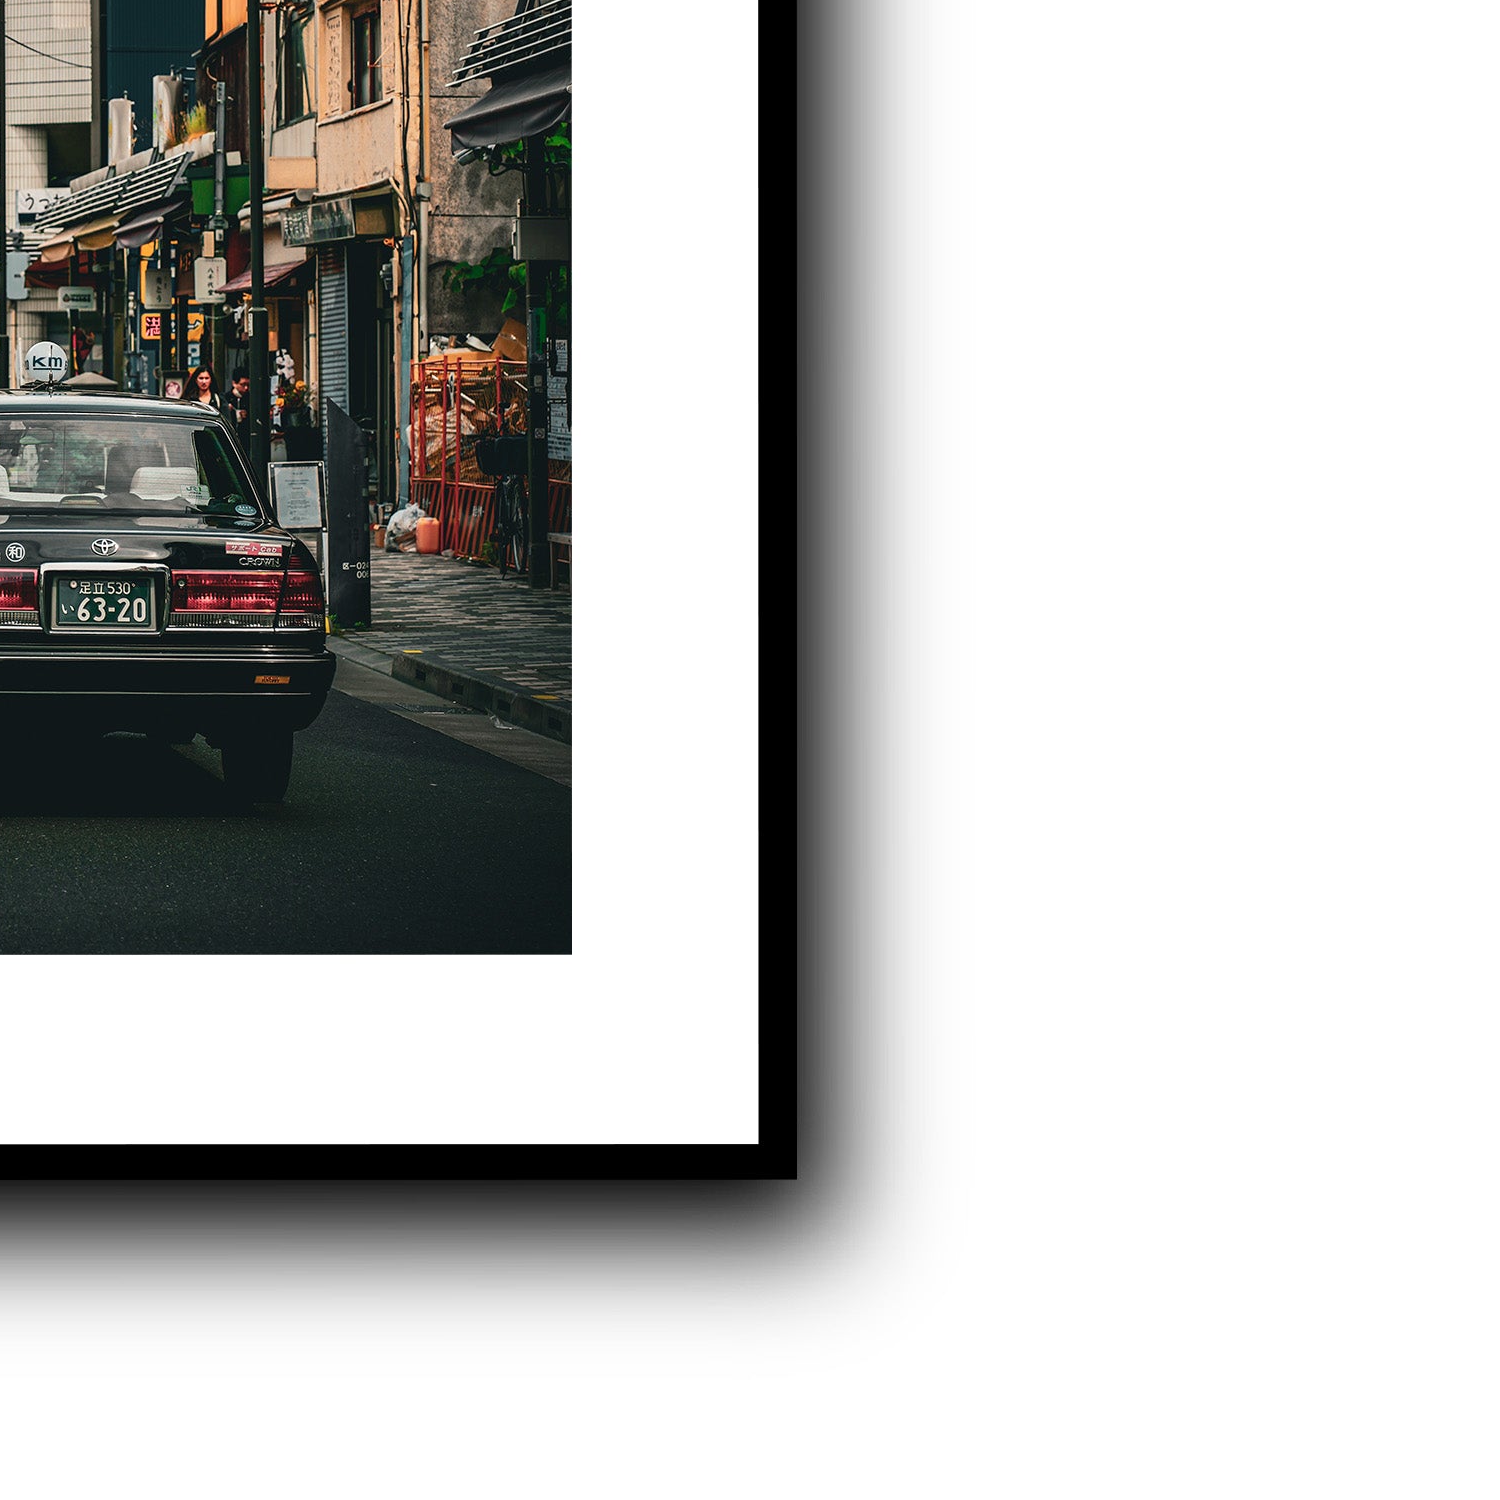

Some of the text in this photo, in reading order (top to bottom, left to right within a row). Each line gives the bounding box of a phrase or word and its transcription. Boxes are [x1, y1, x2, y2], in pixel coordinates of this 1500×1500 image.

[8, 545, 23, 559] 和
[238, 557, 280, 568] CROWN
[79, 581, 131, 595] 足立 530
[61, 597, 146, 622] い 63-20
